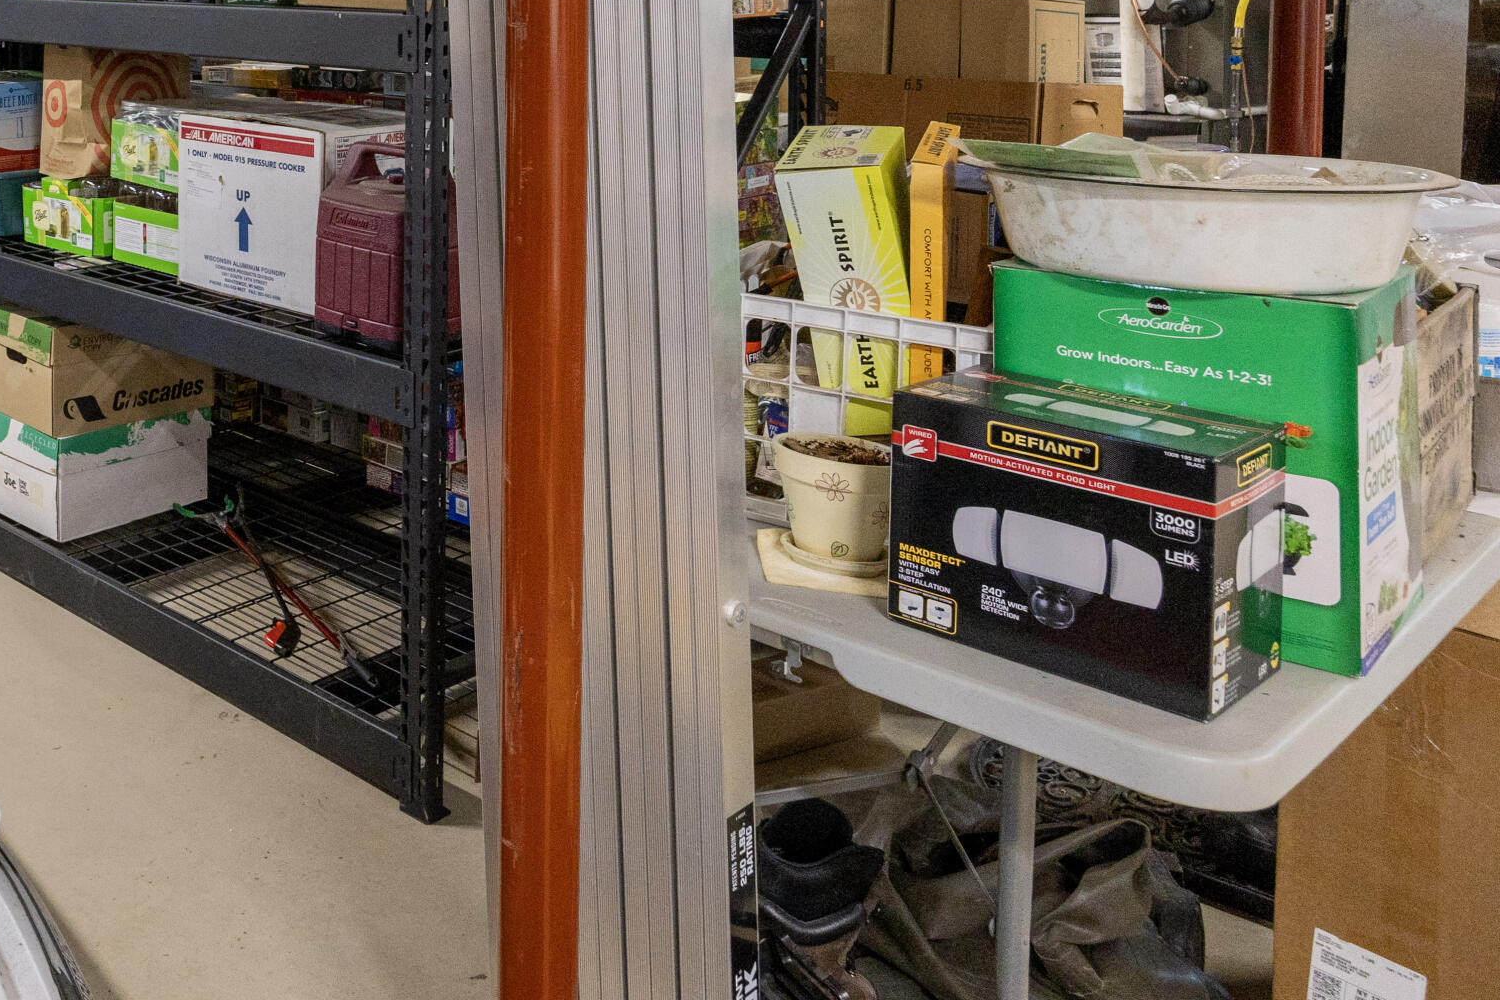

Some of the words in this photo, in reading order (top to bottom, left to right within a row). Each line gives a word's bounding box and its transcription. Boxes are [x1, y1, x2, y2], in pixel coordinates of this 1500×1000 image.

[0, 95, 16, 108] BEEF
[17, 93, 38, 106] BROTH
[191, 130, 207, 141] ALL
[208, 132, 254, 148] AMERICAN
[782, 147, 806, 165] EARTH
[796, 129, 818, 145] SPIRIT
[123, 144, 136, 156] Ball
[192, 149, 208, 158] ONLY
[213, 152, 234, 162] MODEL
[235, 156, 246, 164] 915
[247, 157, 277, 168] PRESSURE
[278, 162, 306, 173] COOKER
[236, 189, 250, 202] UP
[34, 208, 48, 221] Ball
[829, 216, 855, 272] SPIRIT
[924, 228, 933, 279] COMFORT
[204, 254, 232, 265] WISCONSIN
[233, 260, 260, 272] ALUMINUM
[261, 266, 286, 277] FOUNDRY
[925, 281, 933, 307] WITH
[1116, 313, 1202, 335] AeroGarden
[1056, 345, 1093, 360] Grow
[1203, 366, 1223, 379] As
[1227, 369, 1272, 386] 1-2-3!
[908, 428, 932, 439] WIRED
[1001, 430, 1084, 459] DEFIANT
[969, 452, 1053, 478] MOTION-ACTIVATED
[1056, 472, 1086, 485] FLOOD
[1088, 479, 1116, 492] LIGHT
[1186, 461, 1206, 470] BLACK
[1242, 453, 1269, 477] DEFIANT
[3, 471, 16, 490] Joe
[1364, 456, 1398, 502] Garden
[1155, 511, 1195, 529] 3000
[1155, 522, 1195, 538] LUMENS
[899, 551, 941, 569] SENSOR
[1165, 549, 1194, 566] LED
[898, 559, 918, 571] WITH
[920, 565, 940, 576] EASY
[898, 566, 924, 578] 3-STEP
[898, 573, 951, 594] INSTALLATION
[981, 593, 1006, 605] EXTRA
[1007, 601, 1028, 612] WIDE
[981, 599, 1009, 611] MOTION
[981, 604, 1020, 621] DETECTION
[738, 822, 747, 855] LBS.
[745, 825, 754, 876] RATING
[739, 856, 748, 887] 250
